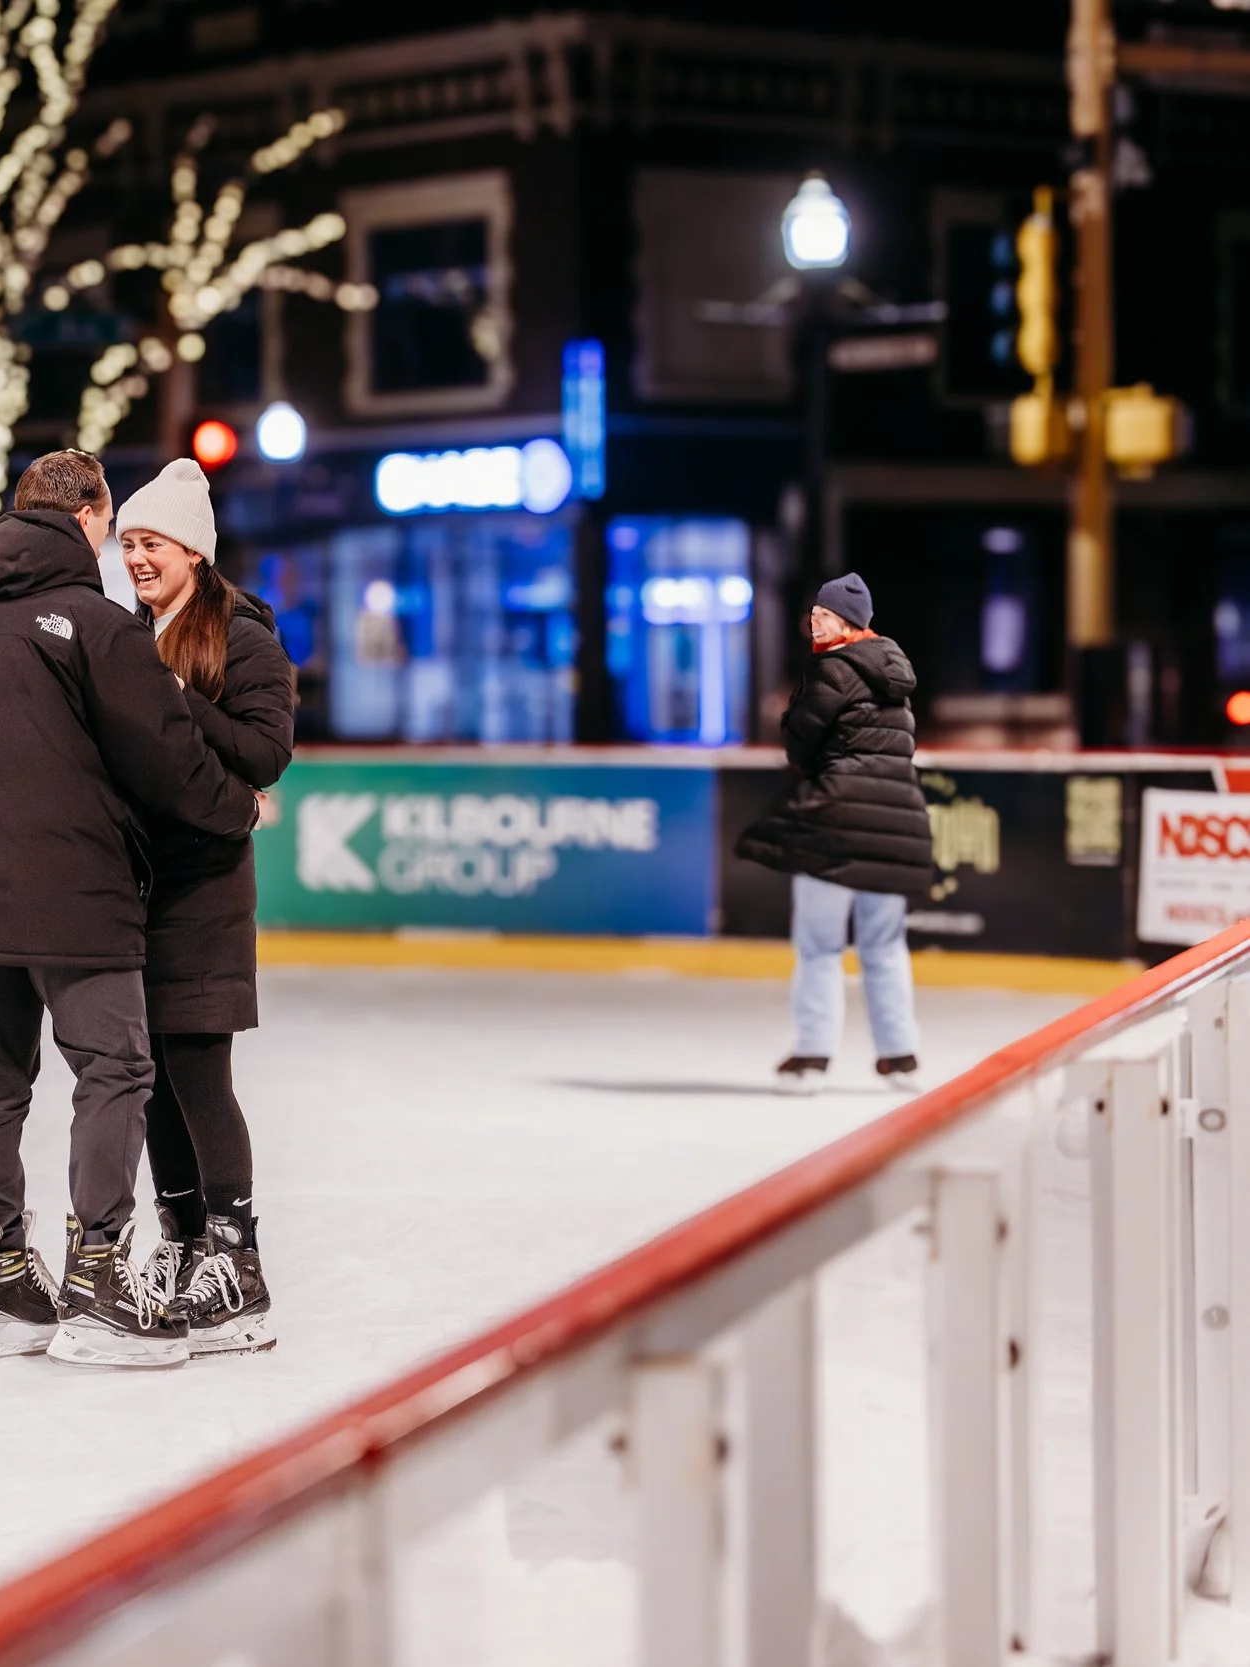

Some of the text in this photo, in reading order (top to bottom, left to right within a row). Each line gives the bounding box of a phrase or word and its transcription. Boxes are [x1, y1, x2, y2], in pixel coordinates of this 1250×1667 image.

[35, 615, 61, 629] NORTH
[40, 623, 61, 636] FACE
[50, 613, 64, 623] THE
[384, 795, 658, 850] KILBOURNE
[1159, 813, 1250, 861] NDSC
[378, 838, 556, 897] GROUP
